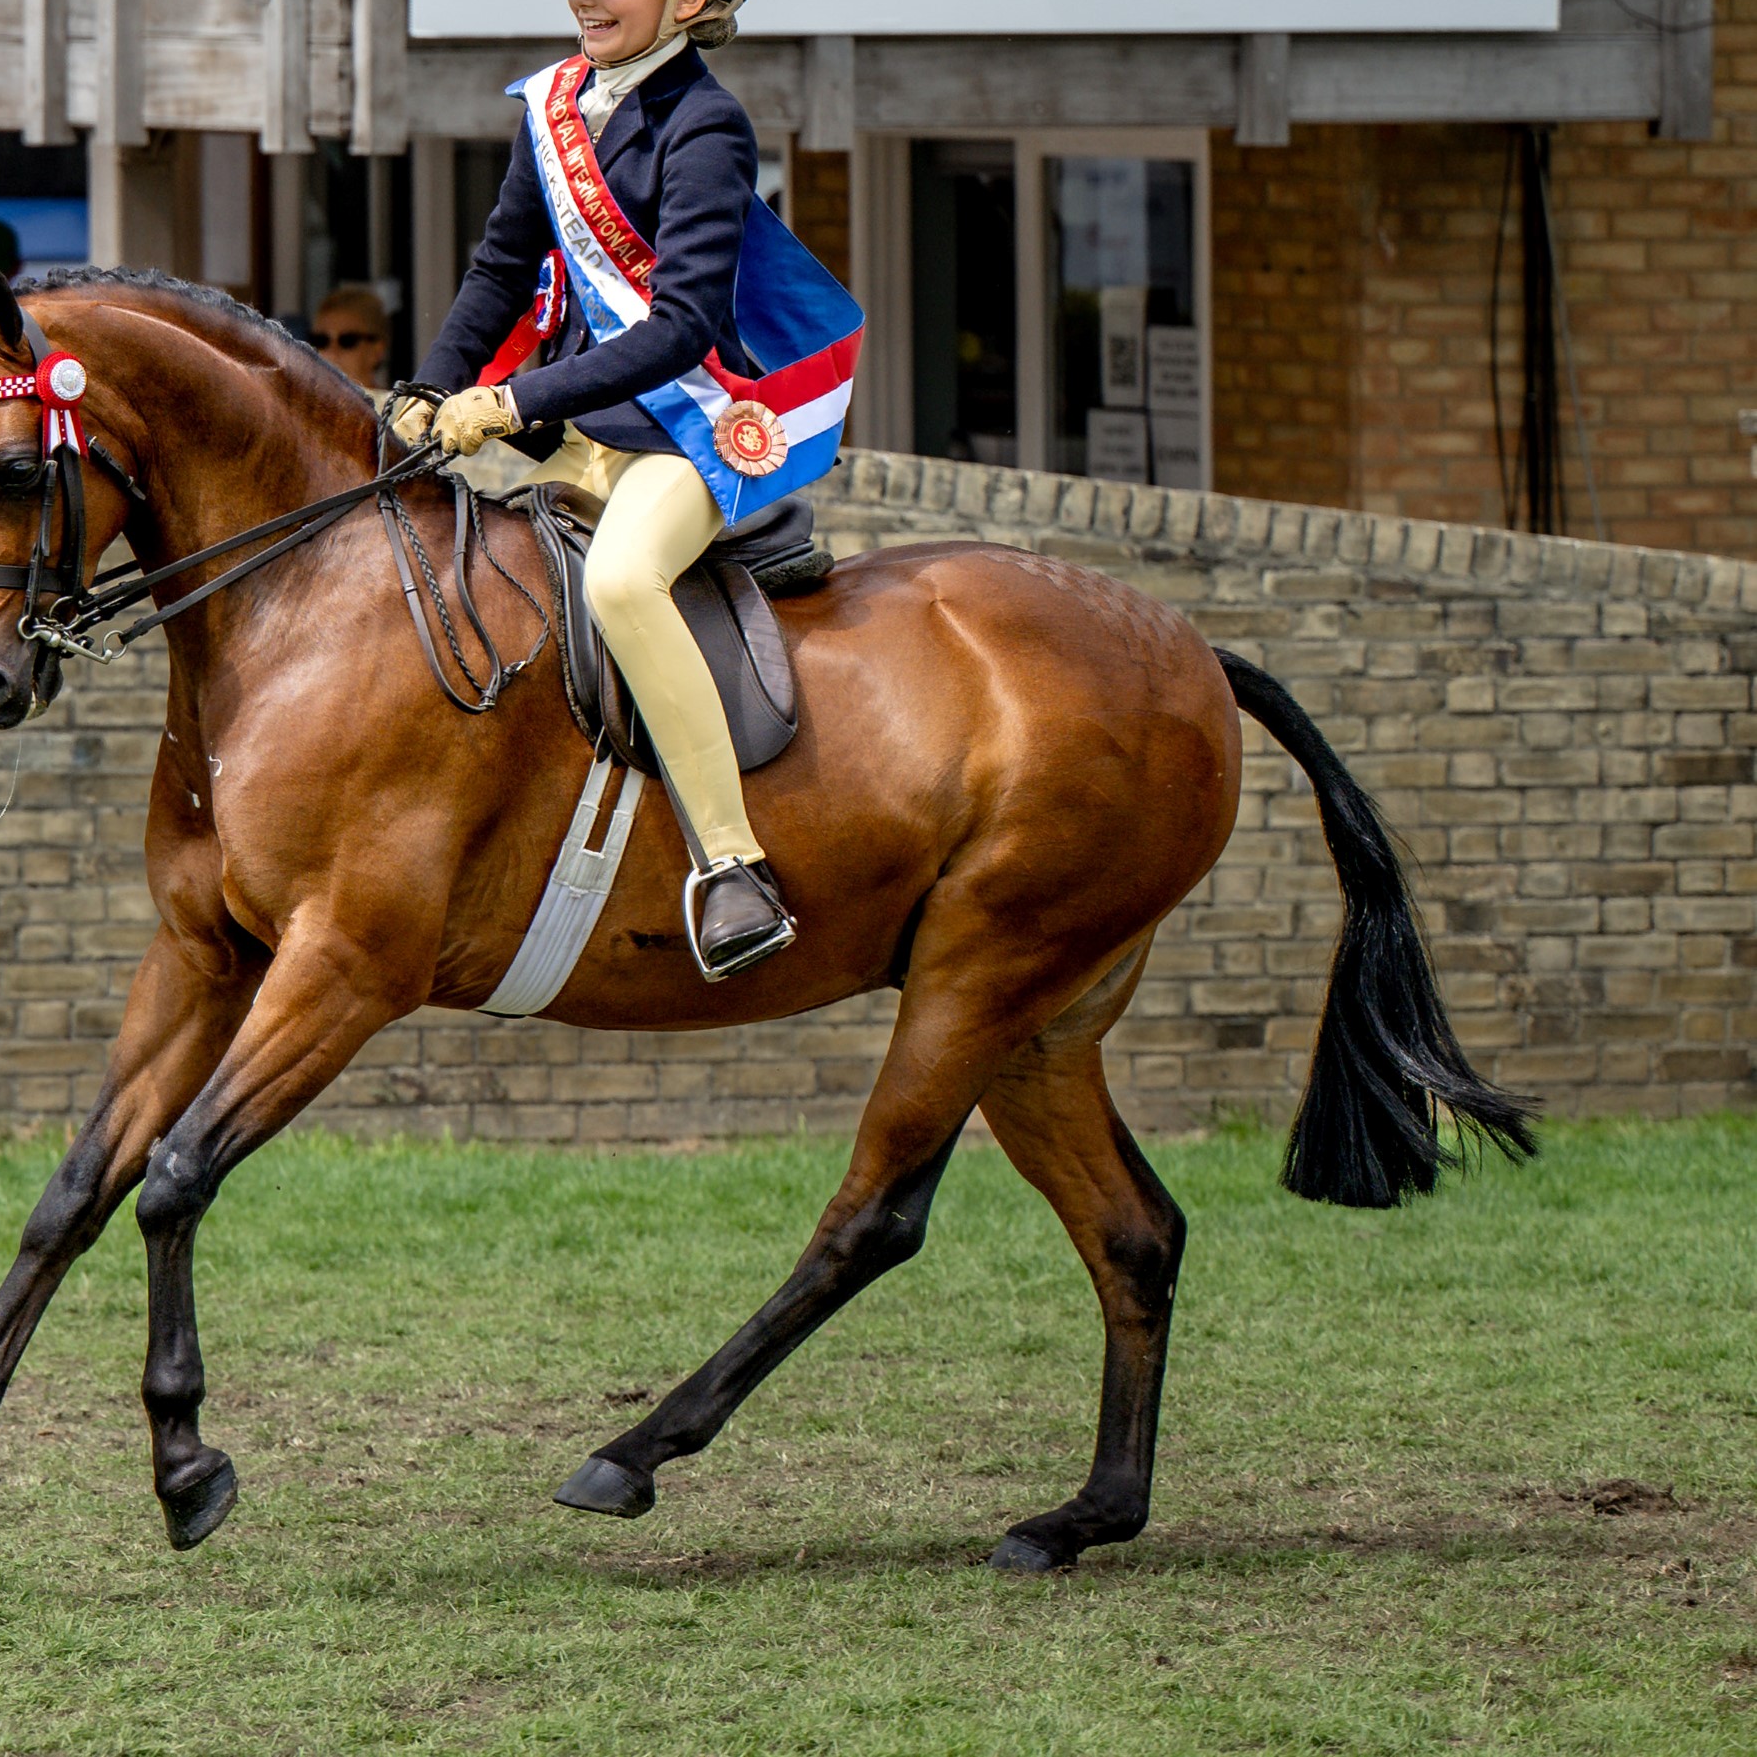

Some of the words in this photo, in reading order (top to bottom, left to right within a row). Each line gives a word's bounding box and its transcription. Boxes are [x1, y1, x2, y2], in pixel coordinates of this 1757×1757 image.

[539, 133, 604, 269] HICKSTEAD
[550, 94, 579, 150] ROYAL
[565, 145, 637, 266] INTERNATIONAL
